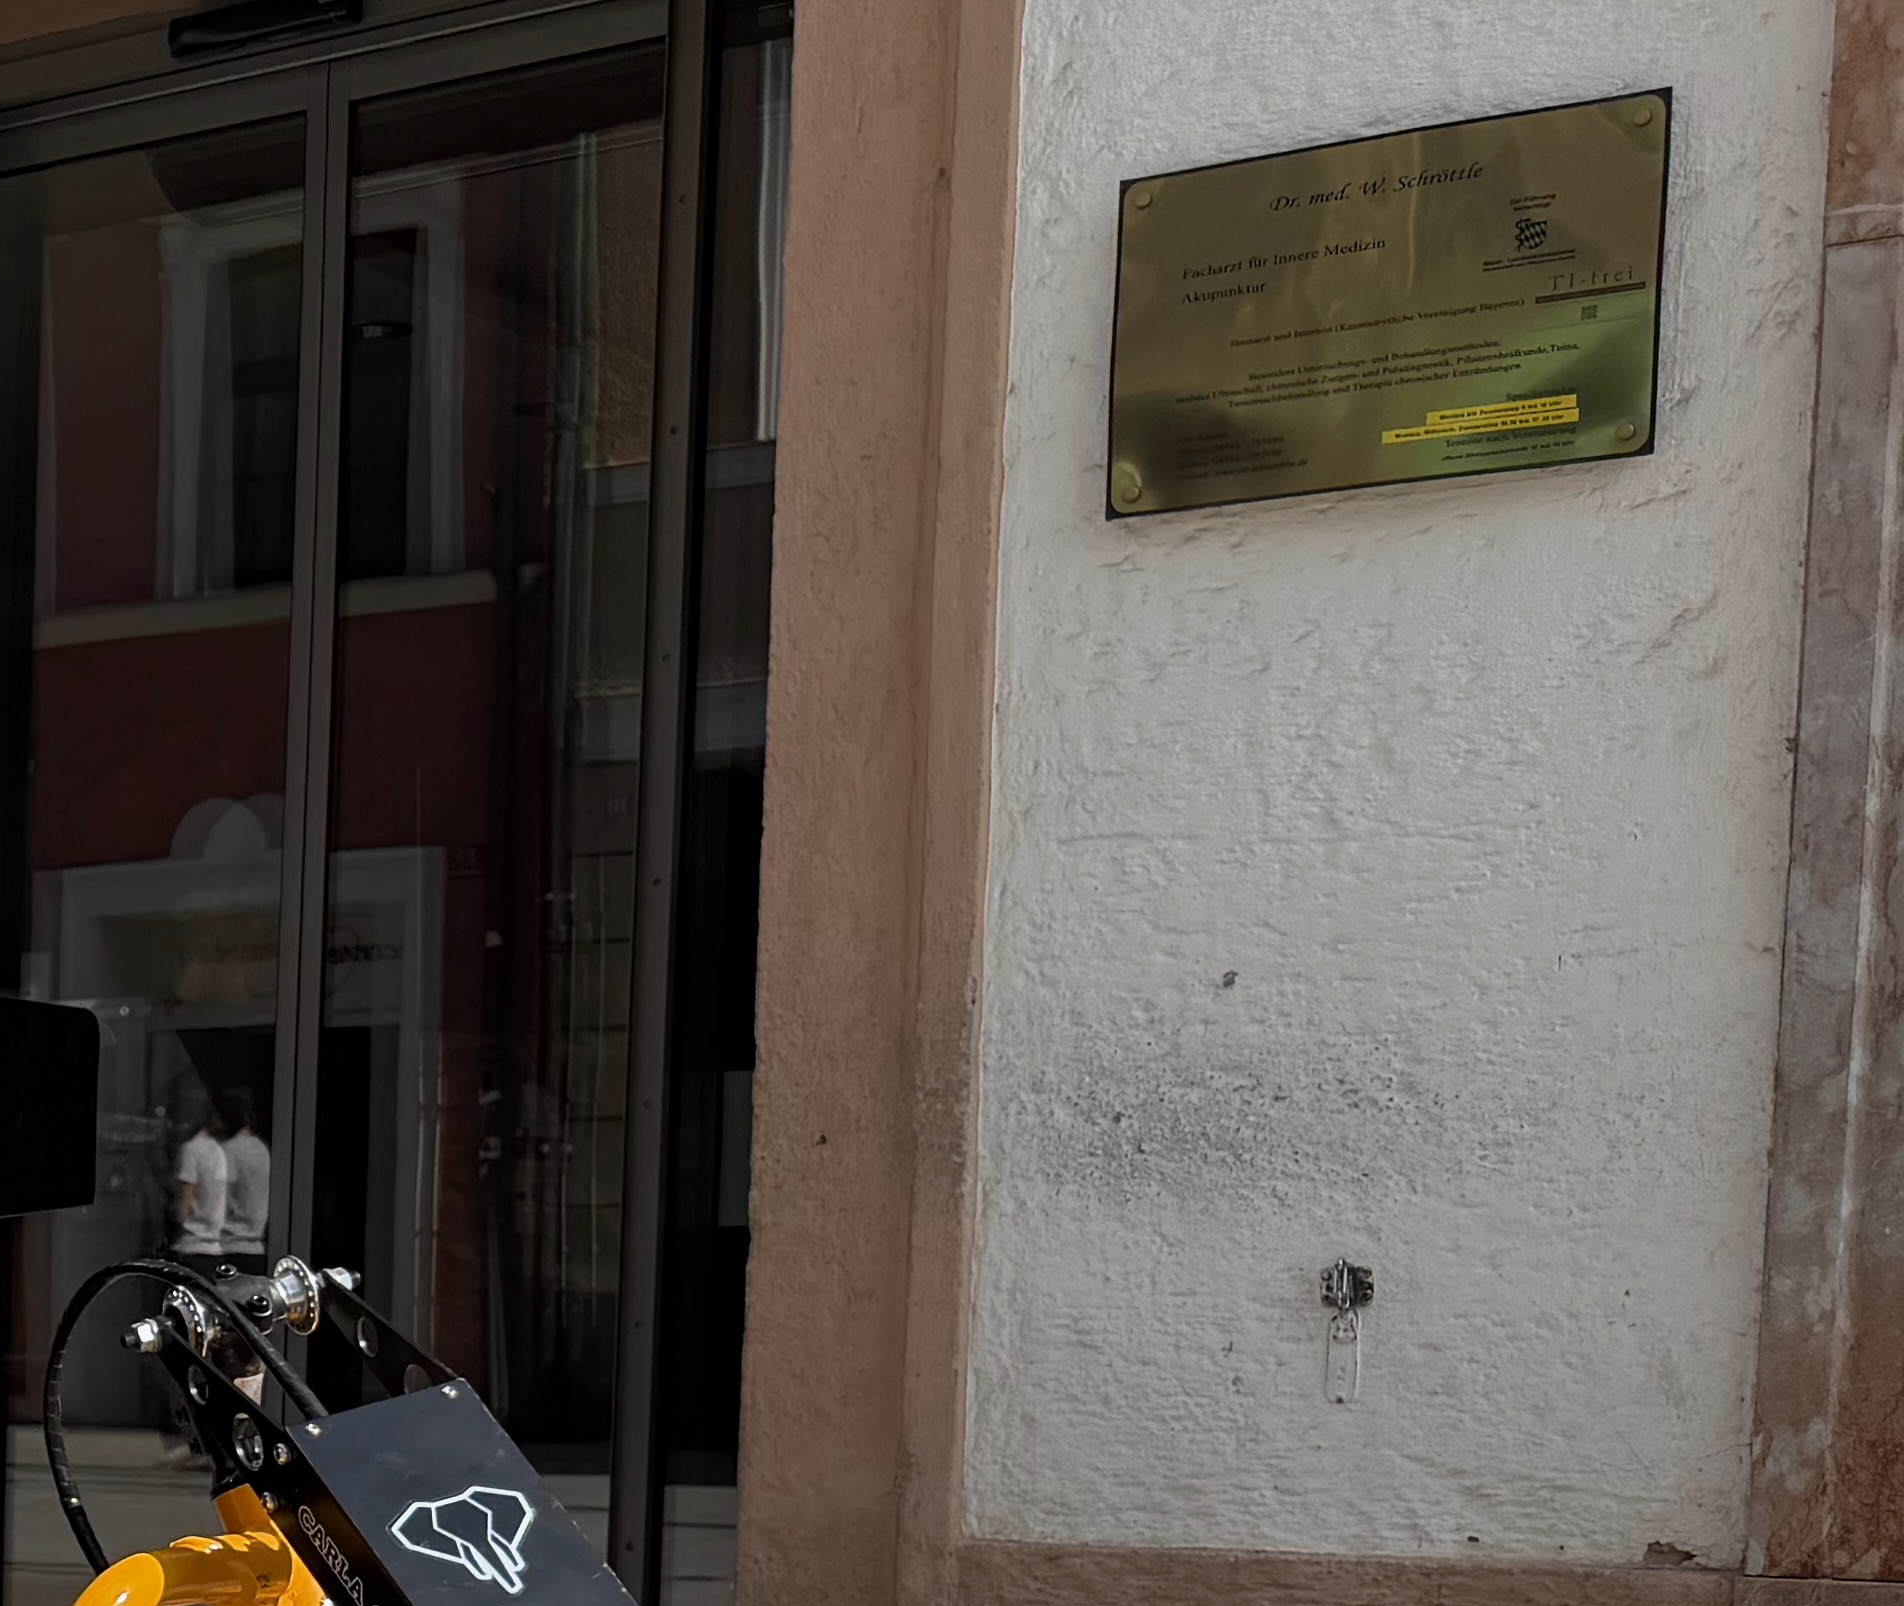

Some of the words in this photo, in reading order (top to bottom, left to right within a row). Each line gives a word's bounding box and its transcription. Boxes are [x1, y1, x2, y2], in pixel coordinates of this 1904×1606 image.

[1269, 195, 1300, 212] Dr.
[1309, 183, 1350, 205] med.
[1359, 177, 1387, 196] W.
[1393, 162, 1484, 192] Schröttle
[1182, 260, 1242, 281] Facharzt
[1249, 256, 1268, 269] für
[1273, 250, 1319, 267] Innere
[1324, 238, 1386, 257] Medizin
[1181, 282, 1267, 305] Akupunktur
